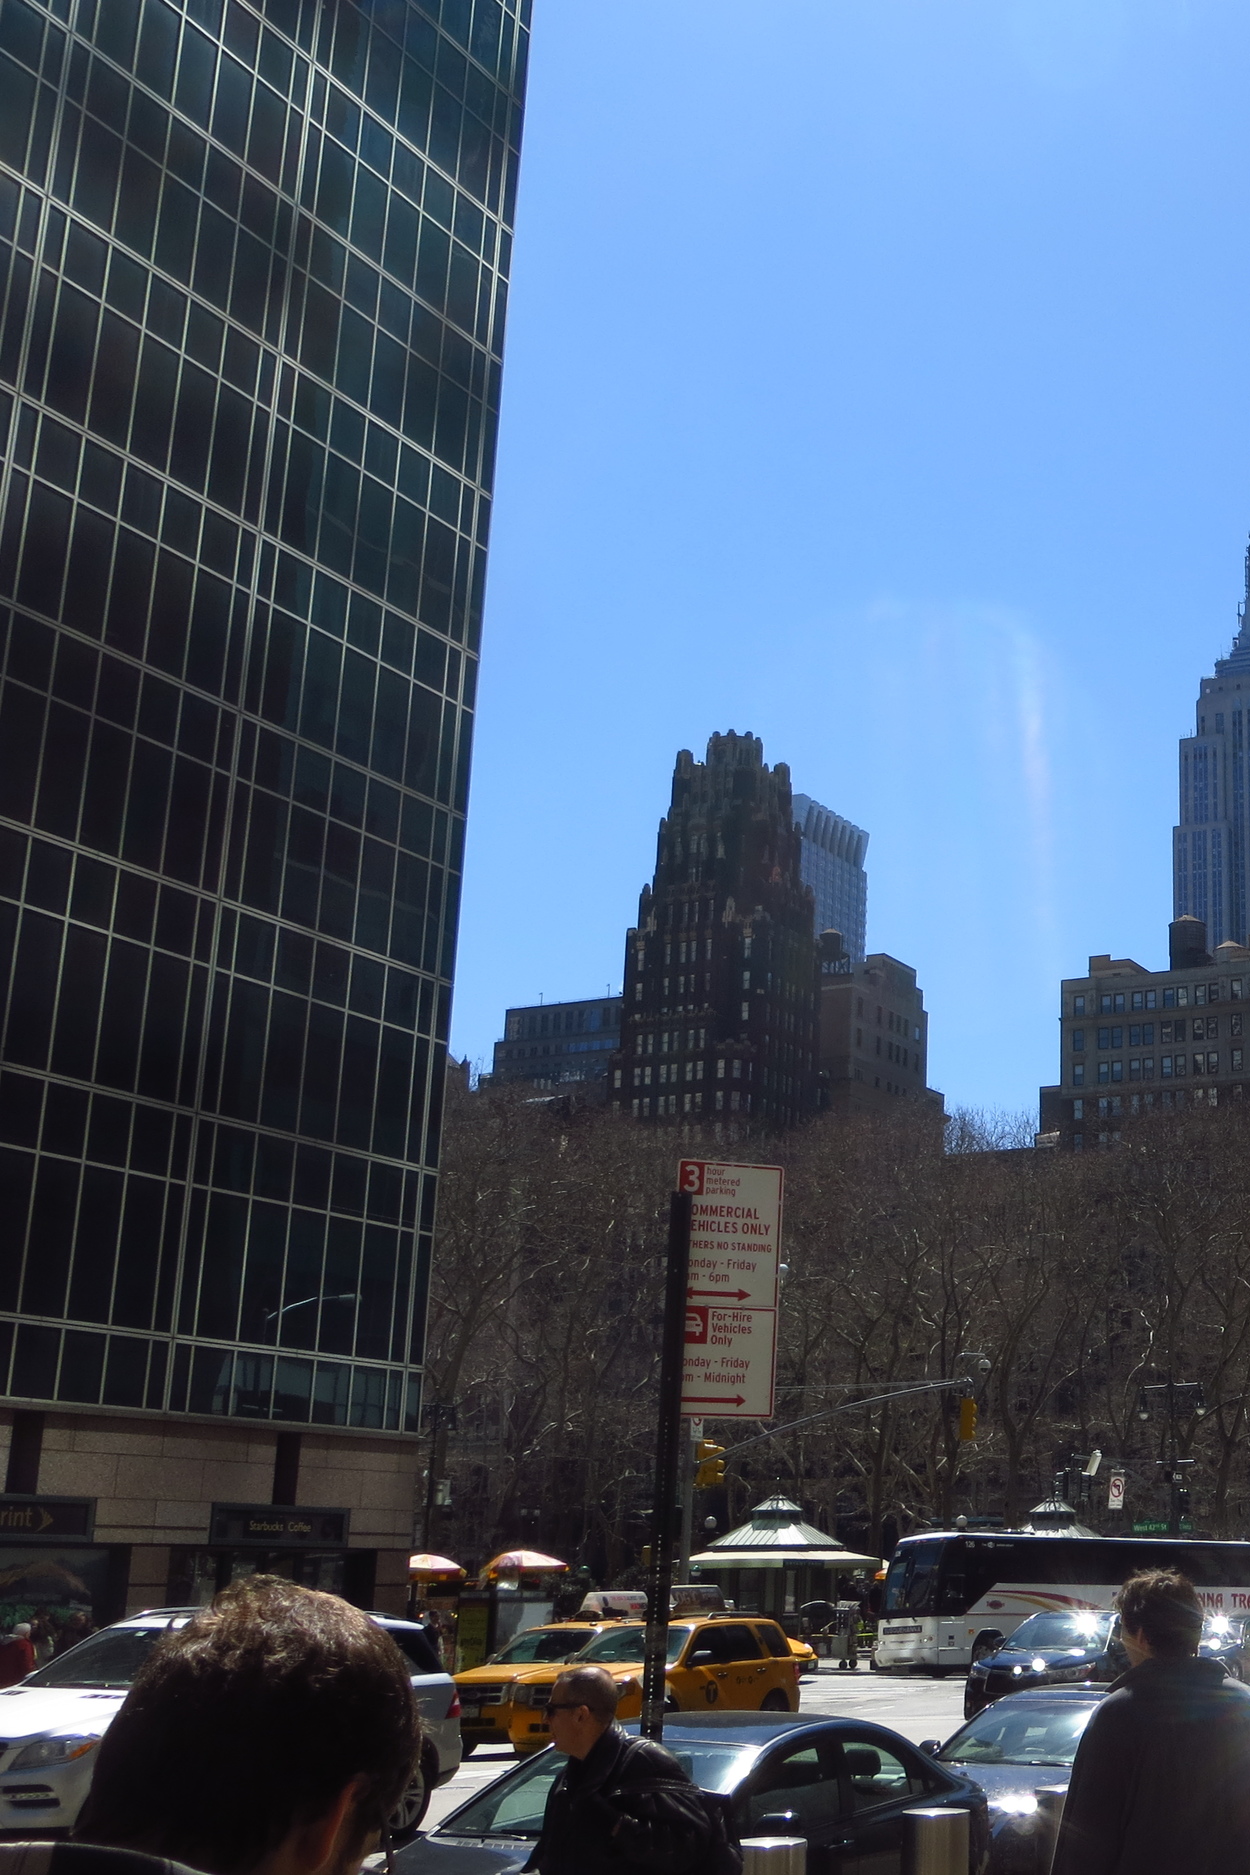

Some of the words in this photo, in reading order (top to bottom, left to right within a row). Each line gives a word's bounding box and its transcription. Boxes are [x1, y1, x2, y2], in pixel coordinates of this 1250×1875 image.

[707, 1167, 725, 1176] hour
[683, 1165, 700, 1192] 3
[706, 1177, 741, 1187] metered
[705, 1187, 736, 1197] parking
[691, 1204, 760, 1220] OMMERCIAL
[690, 1220, 738, 1234] EHICLES
[742, 1222, 771, 1236] ONLY
[690, 1240, 714, 1250] THERS
[717, 1242, 729, 1251] NO
[731, 1242, 772, 1253] STANDING
[688, 1258, 718, 1271] onday
[727, 1259, 757, 1272] Friday
[709, 1273, 730, 1284] 6pm
[711, 1310, 753, 1323] For-Hire
[712, 1323, 752, 1335] Vehicles
[710, 1335, 733, 1348] Only
[683, 1356, 711, 1370] onday
[721, 1357, 751, 1371] Friday
[704, 1372, 746, 1386] Midnight
[0, 1506, 33, 1527] rint
[249, 1520, 284, 1532] Starbucks
[288, 1521, 312, 1532] Coffee
